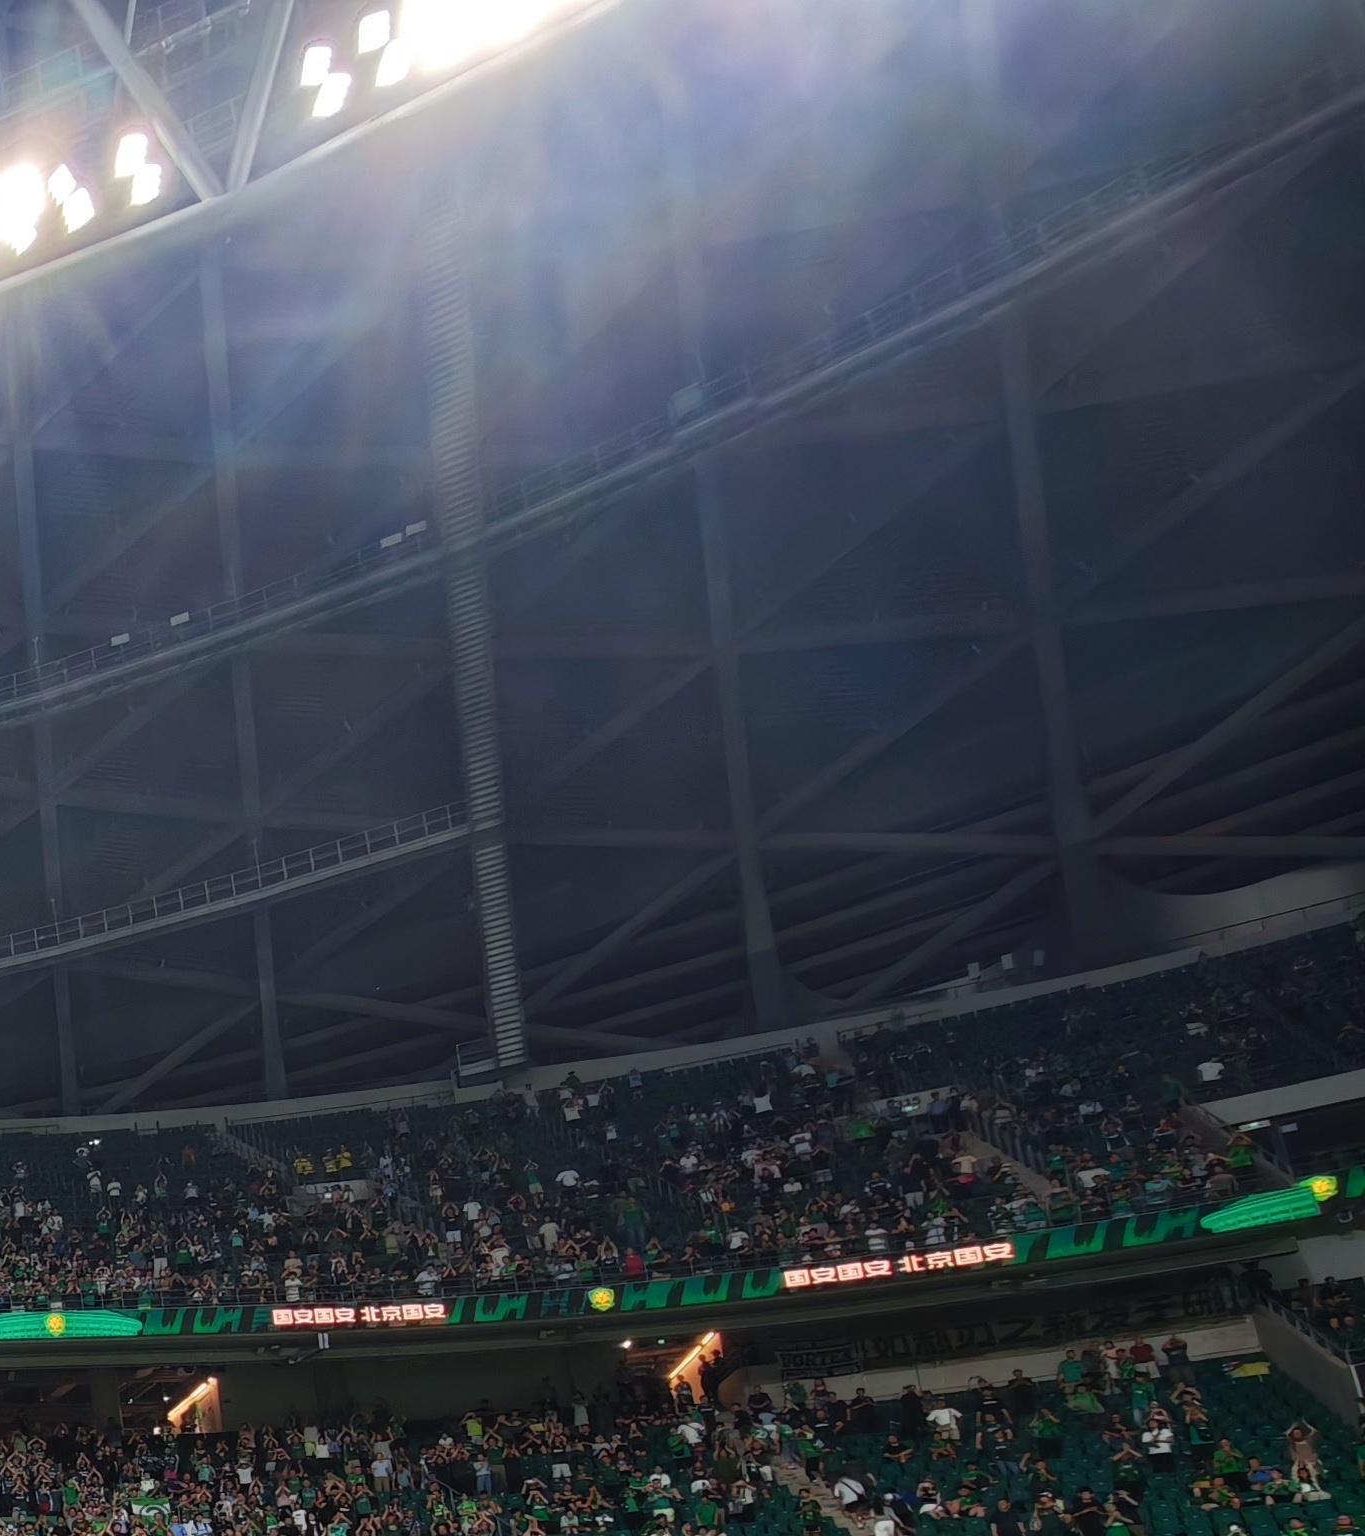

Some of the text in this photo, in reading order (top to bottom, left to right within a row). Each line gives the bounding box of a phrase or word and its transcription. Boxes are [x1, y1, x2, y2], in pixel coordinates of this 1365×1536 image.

[783, 1242, 1016, 1288] 国安国安 北京国安
[272, 1303, 446, 1326] 国安国安 北京国安
